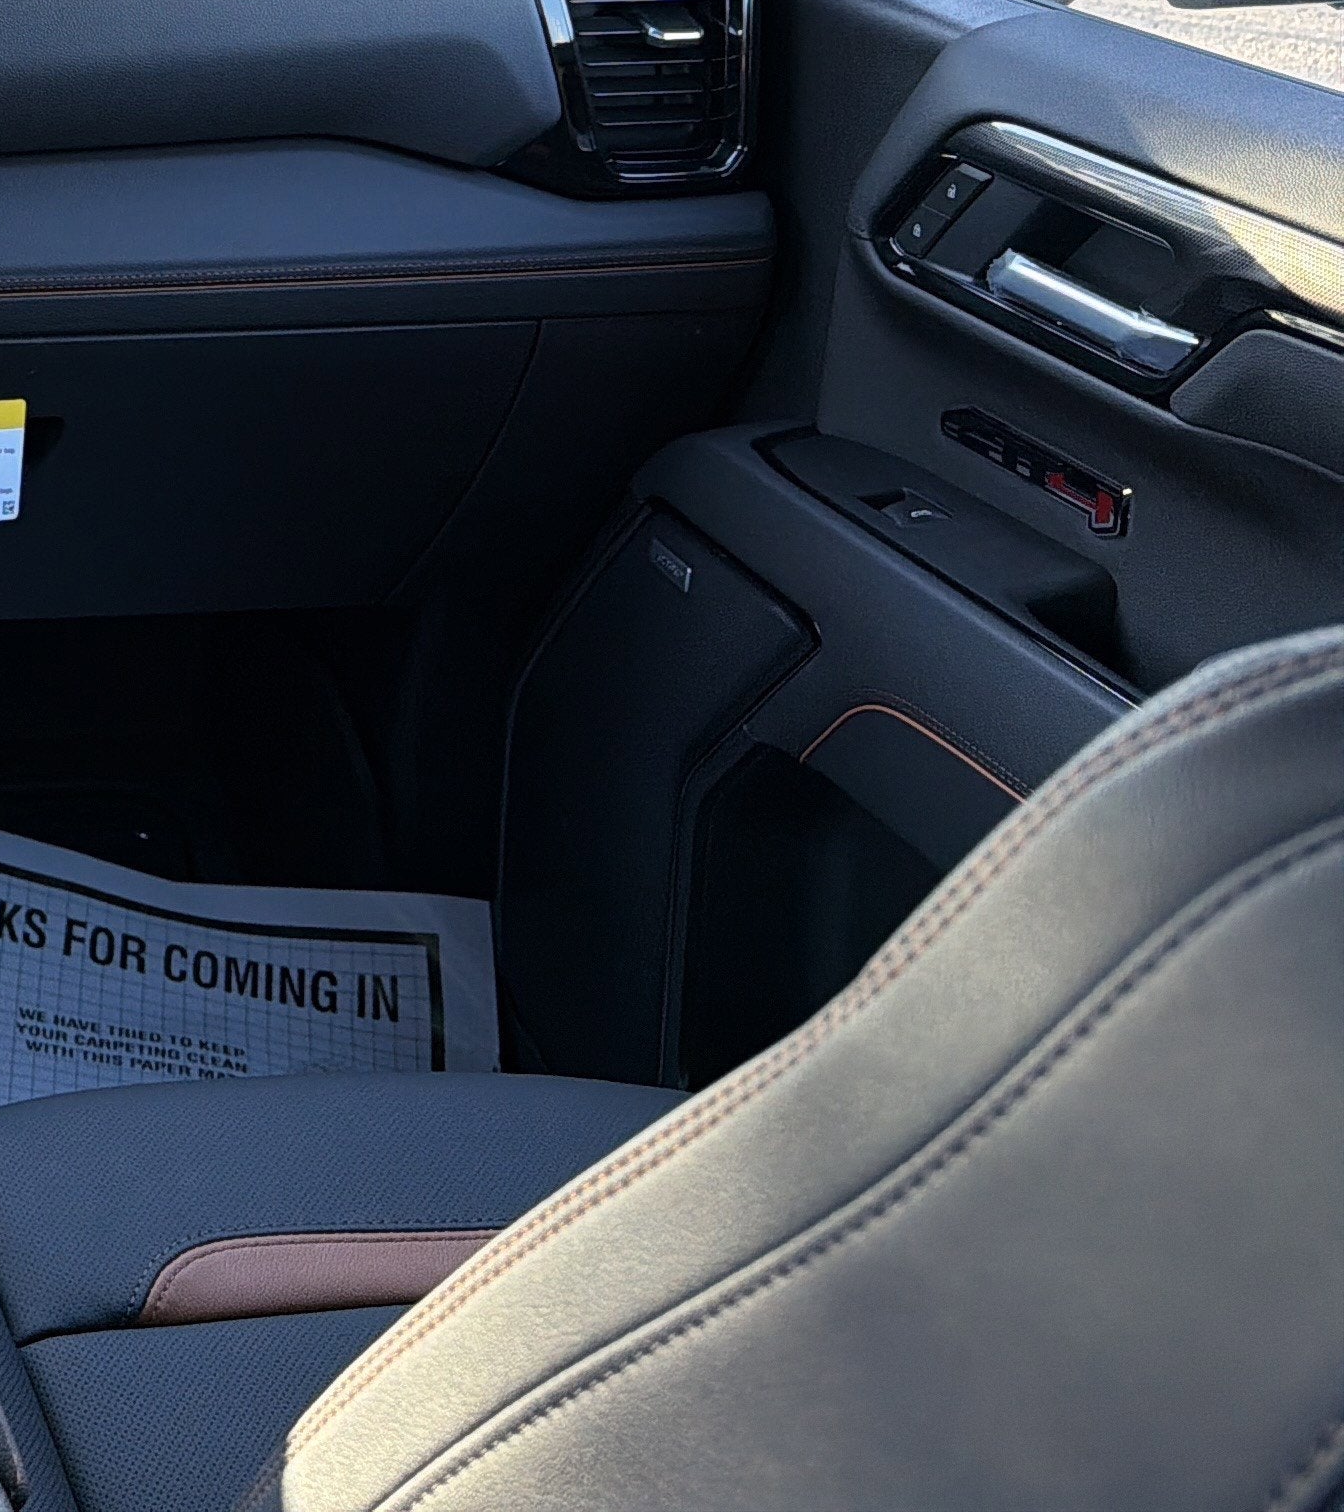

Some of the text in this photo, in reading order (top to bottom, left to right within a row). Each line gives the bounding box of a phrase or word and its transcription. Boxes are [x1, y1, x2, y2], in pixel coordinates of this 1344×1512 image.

[62, 917, 147, 975] FOR
[164, 942, 340, 1015] COMING
[355, 972, 401, 1023] IN
[15, 1021, 249, 1075] YOUR CARPETING CLEAN
[18, 1006, 47, 1023] WE
[52, 1014, 101, 1034] HAVE
[108, 1024, 162, 1044] TRIED
[169, 1033, 194, 1048] TO
[25, 1038, 76, 1059] WITH
[81, 1049, 124, 1067] THIS
[129, 1056, 192, 1078] PAPER
